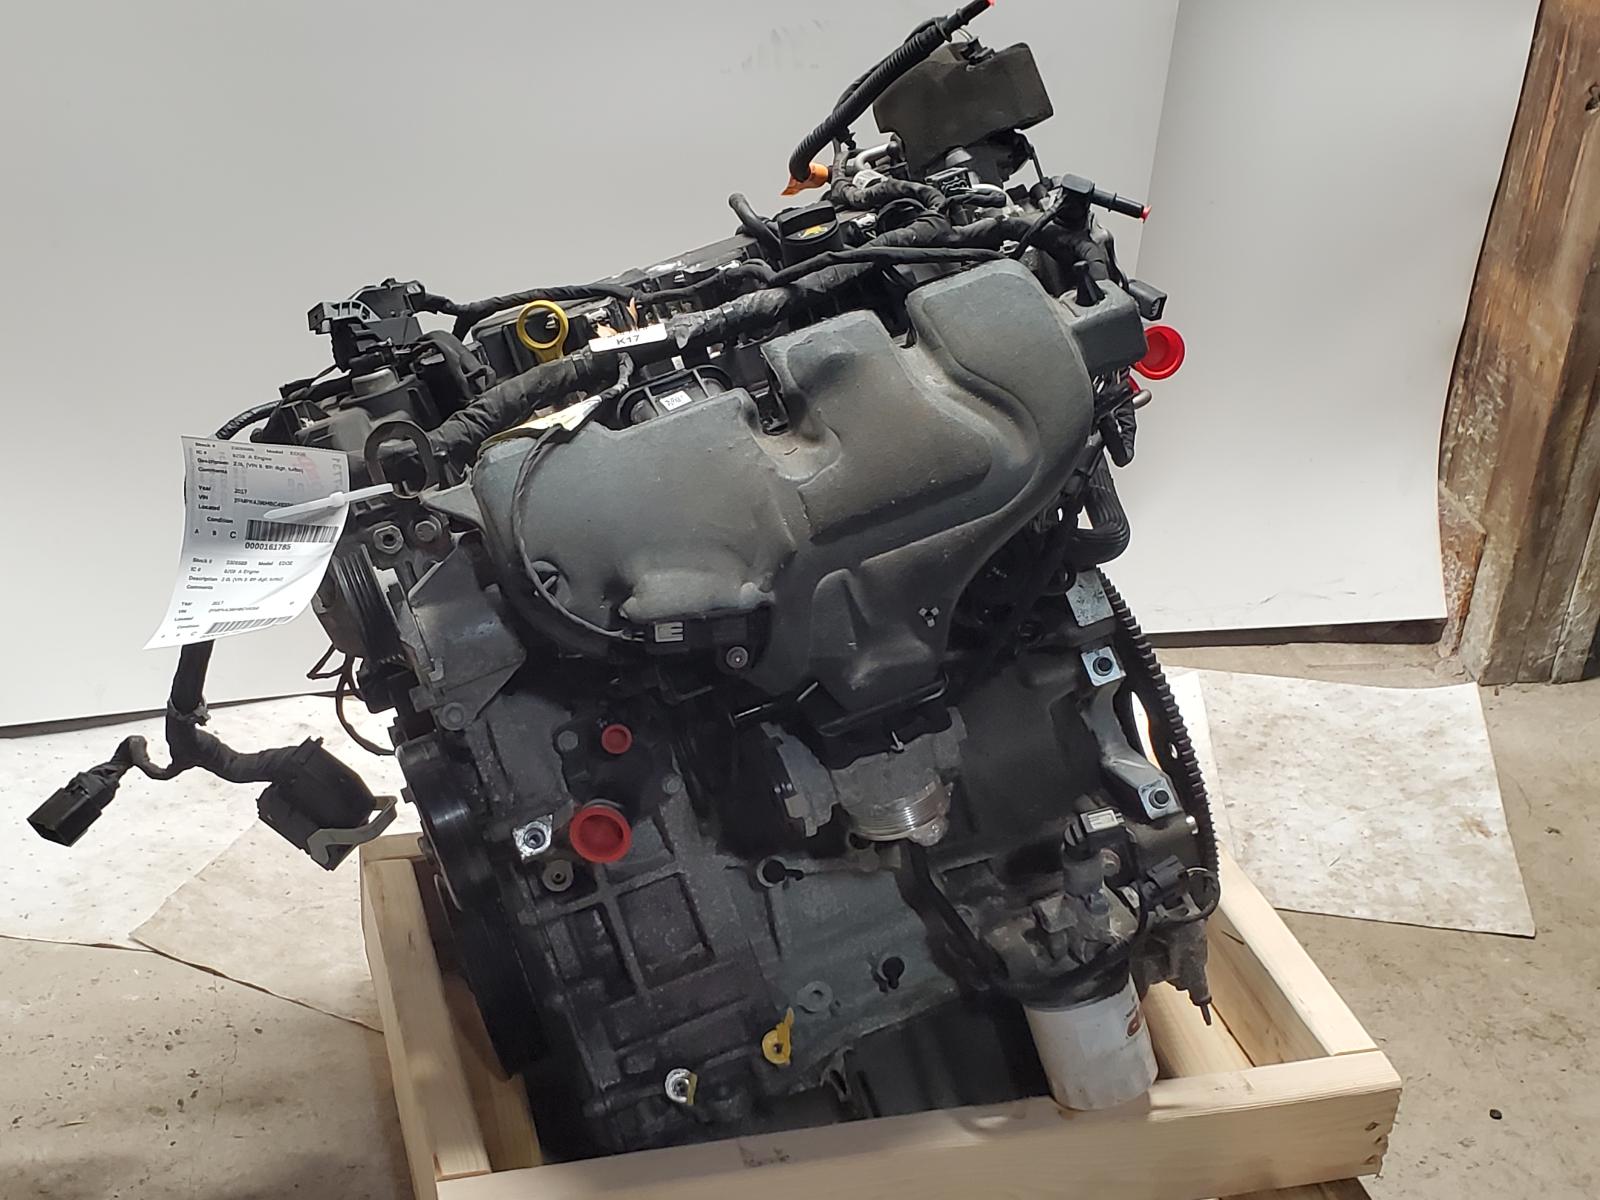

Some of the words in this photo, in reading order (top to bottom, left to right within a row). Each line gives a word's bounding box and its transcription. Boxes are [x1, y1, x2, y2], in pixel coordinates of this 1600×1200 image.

[616, 334, 640, 345] K17
[229, 530, 237, 539] C
[244, 542, 292, 551] 0000161785
